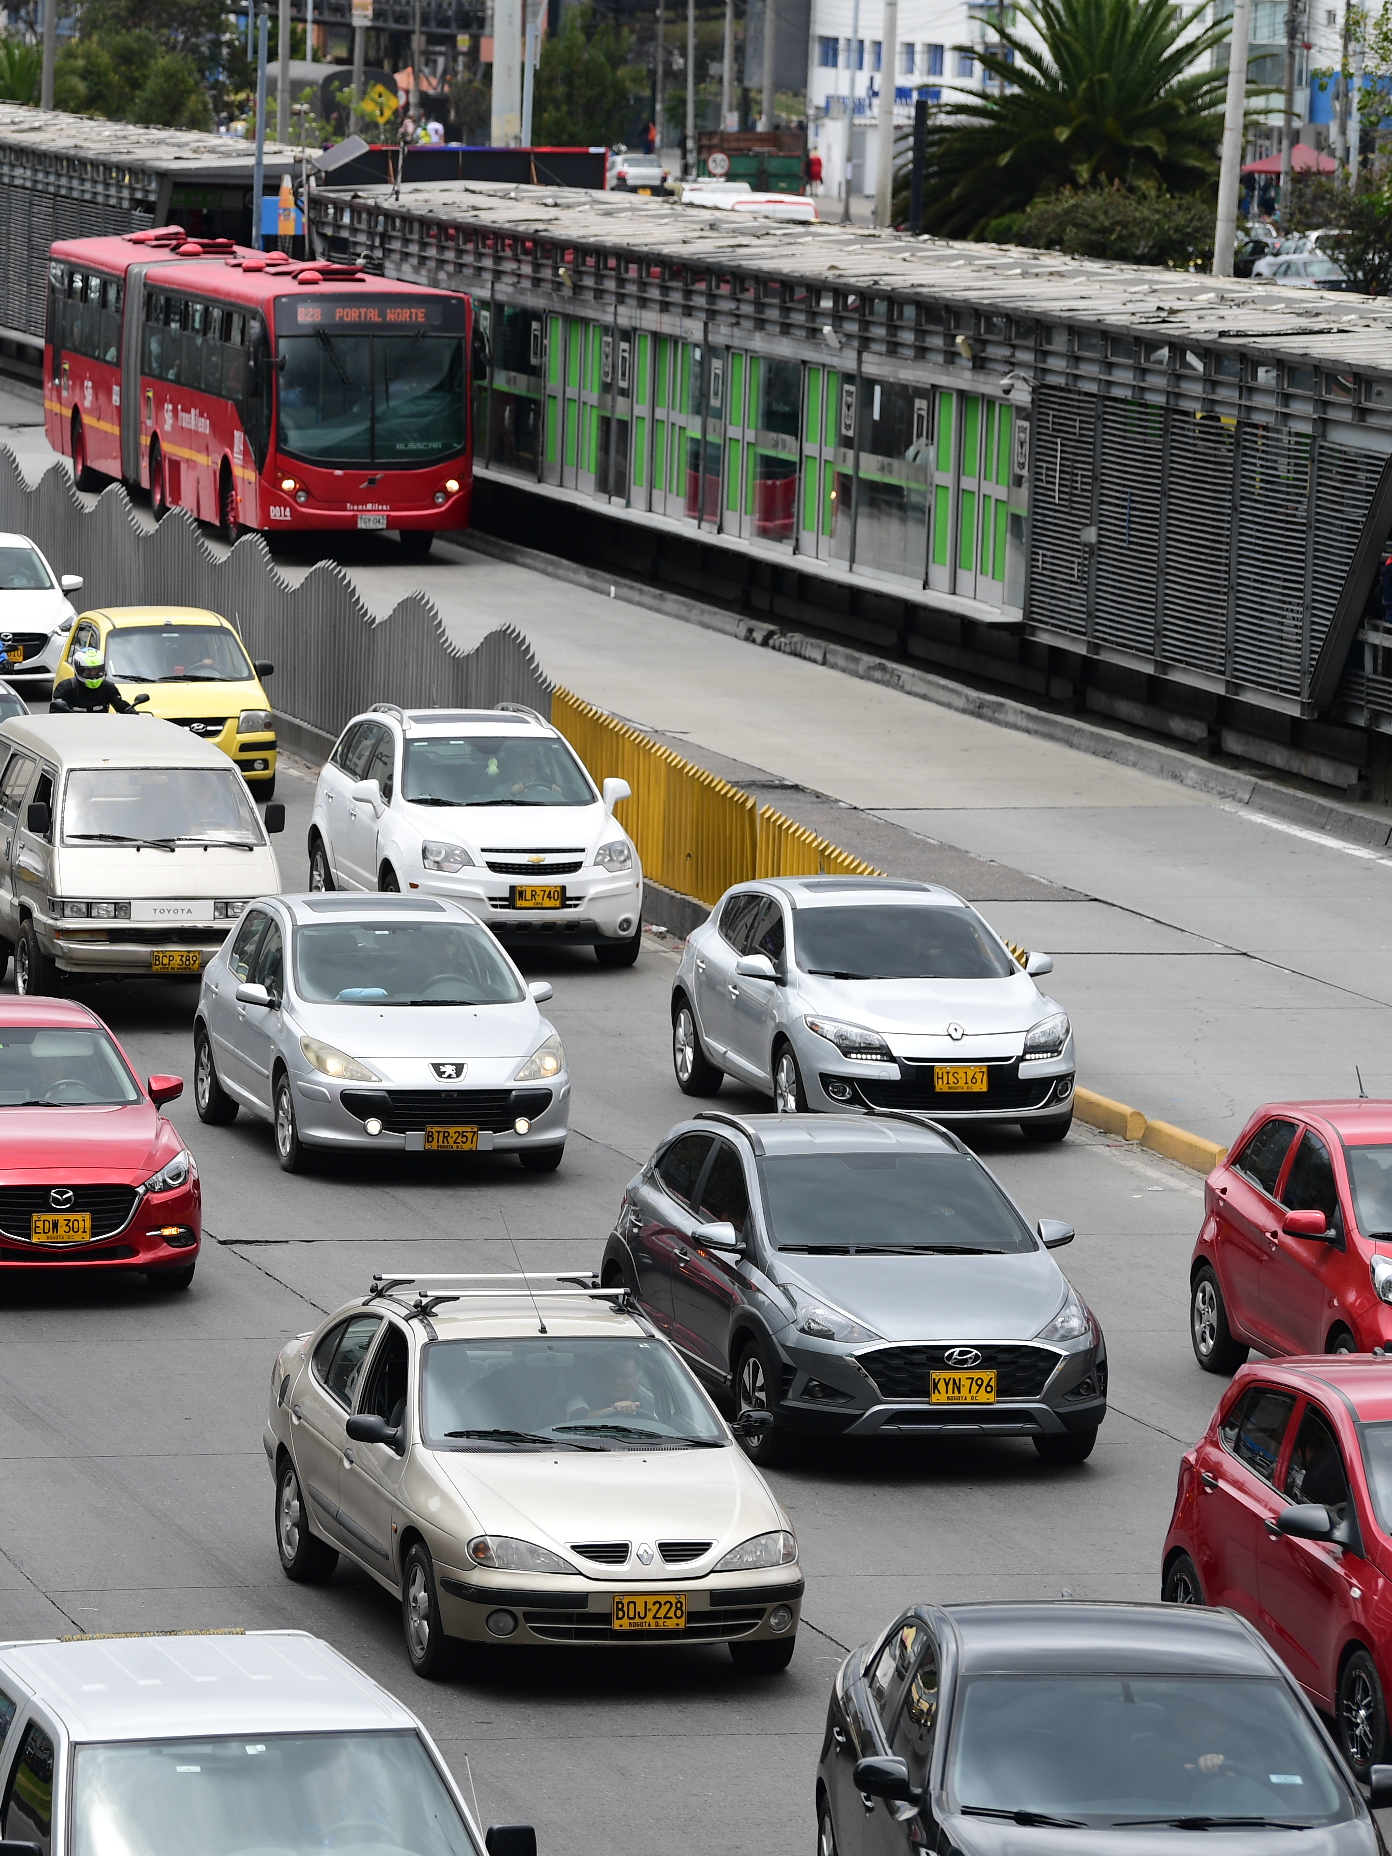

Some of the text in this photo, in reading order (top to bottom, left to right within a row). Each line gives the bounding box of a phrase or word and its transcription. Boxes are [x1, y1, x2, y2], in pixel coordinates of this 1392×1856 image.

[298, 307, 426, 321] B28 PORTAL NORTE
[270, 506, 291, 518] D014
